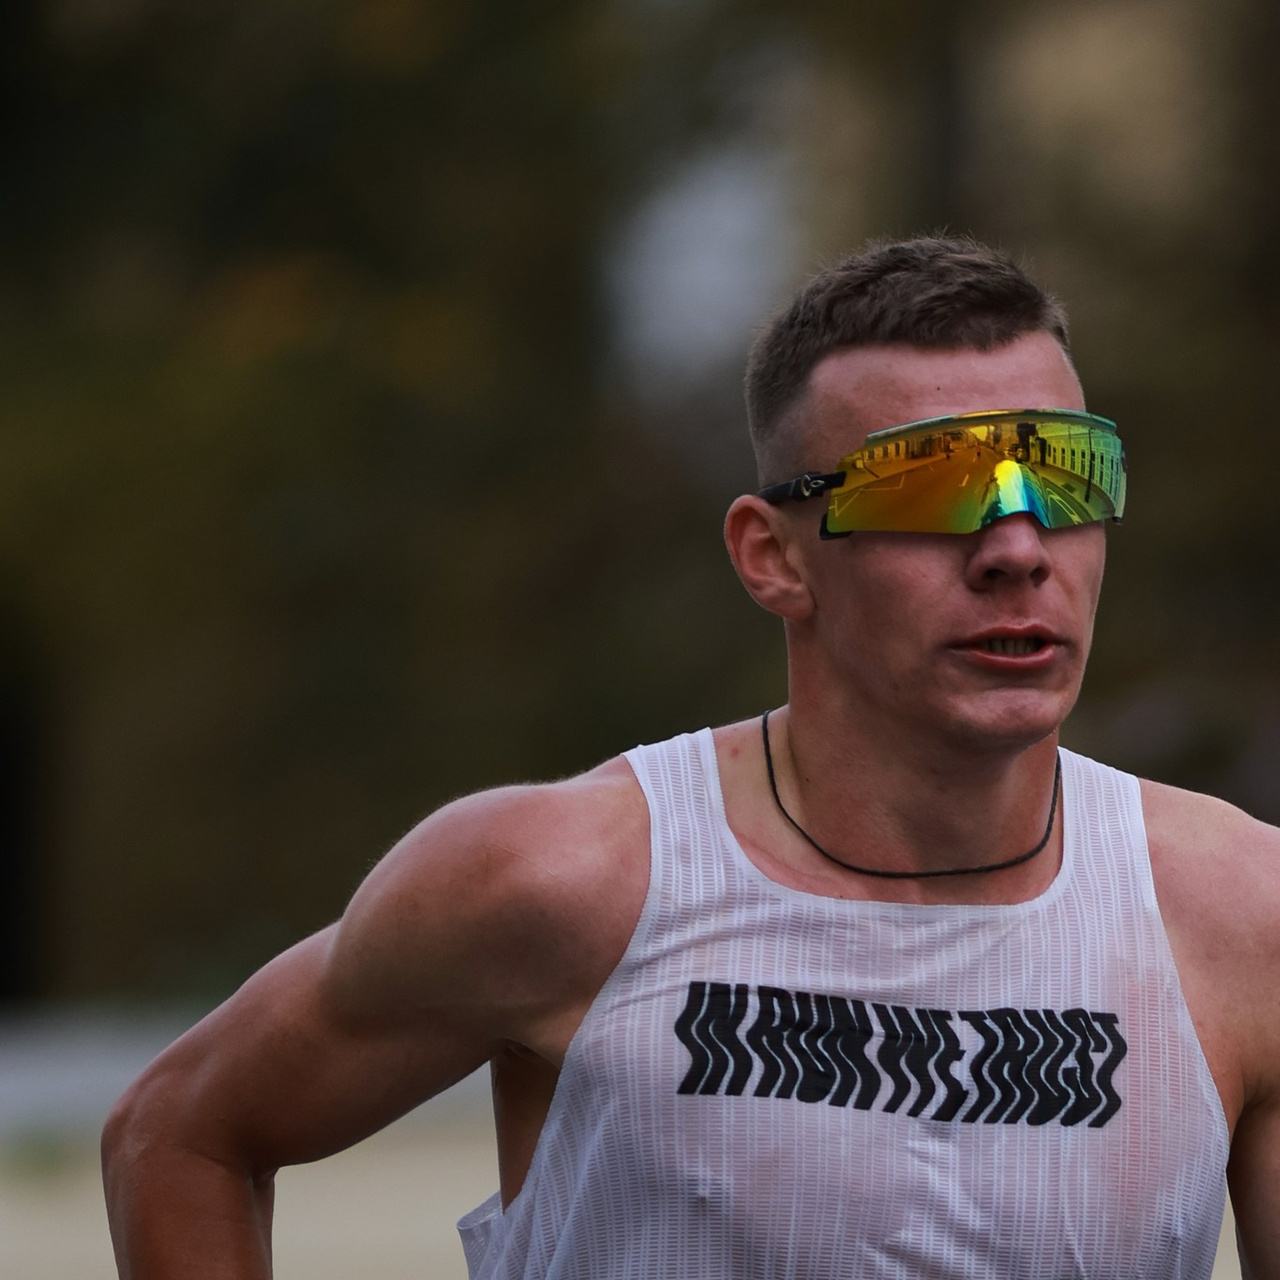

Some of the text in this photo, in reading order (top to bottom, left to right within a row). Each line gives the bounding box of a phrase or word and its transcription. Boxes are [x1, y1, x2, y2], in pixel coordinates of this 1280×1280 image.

[674, 980, 1128, 1129] IN RUN WE TRUST
